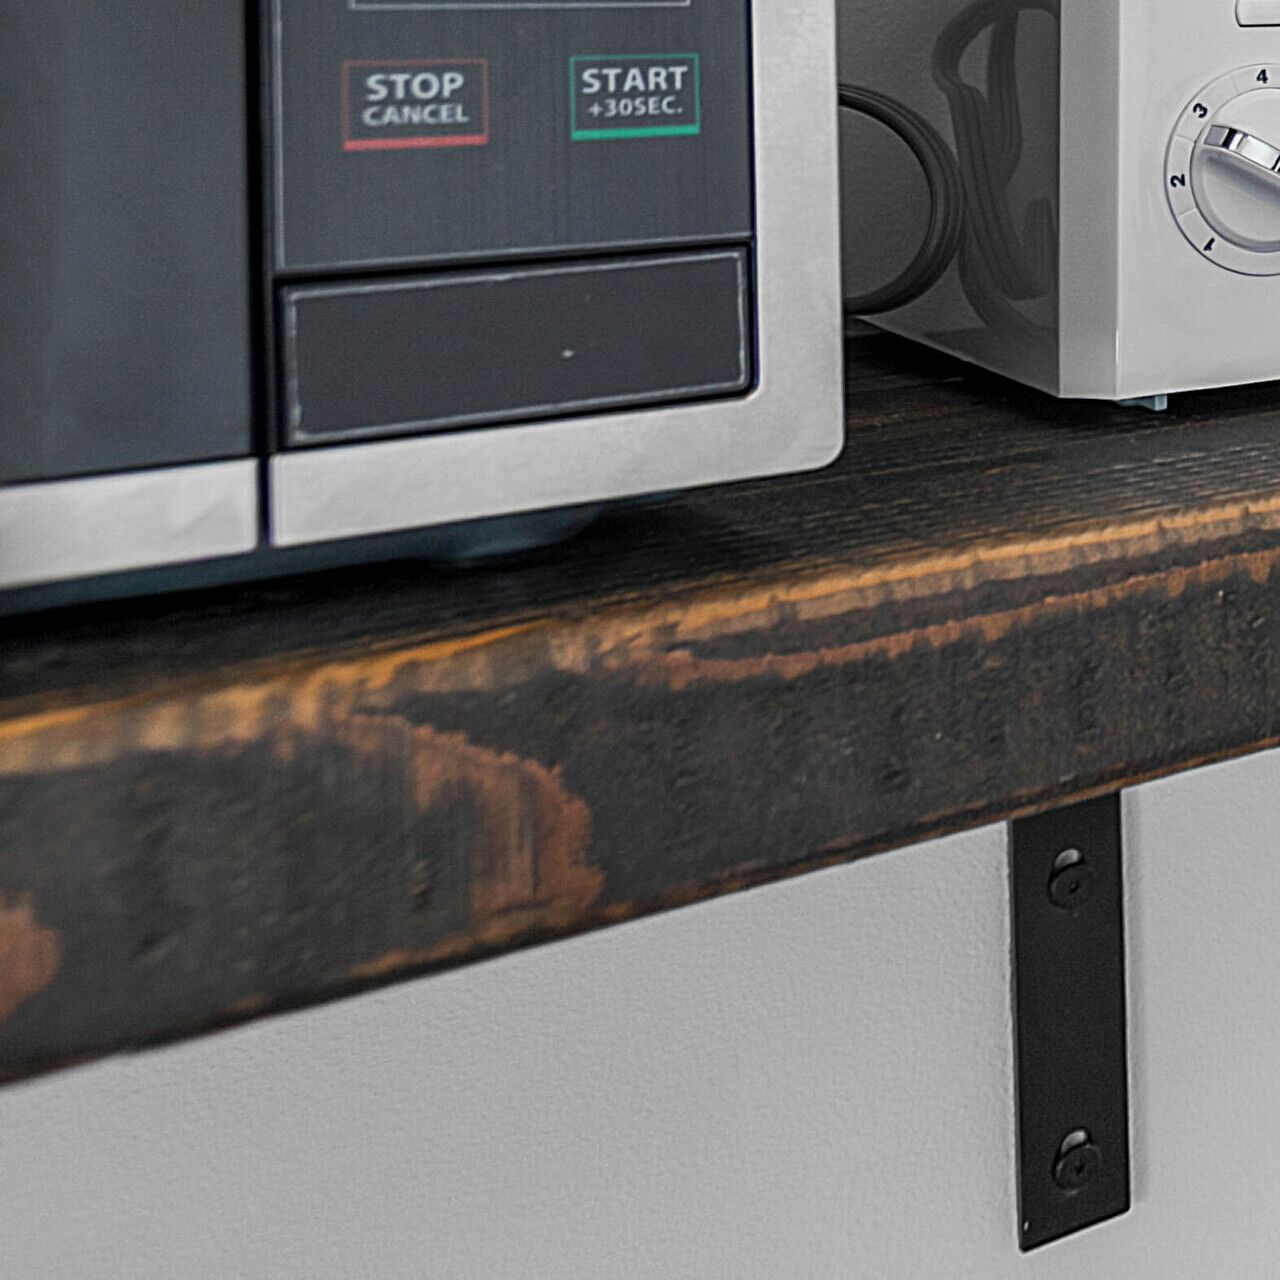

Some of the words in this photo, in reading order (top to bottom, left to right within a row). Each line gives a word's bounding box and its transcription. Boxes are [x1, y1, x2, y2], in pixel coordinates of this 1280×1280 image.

[582, 66, 688, 95] START
[1256, 70, 1269, 84] 4
[365, 73, 464, 101] STOP
[363, 104, 469, 126] CANCEL
[589, 95, 683, 117] +30SEC.
[1193, 103, 1208, 118] 3
[1170, 174, 1185, 188] 2
[1203, 238, 1215, 252] 1
